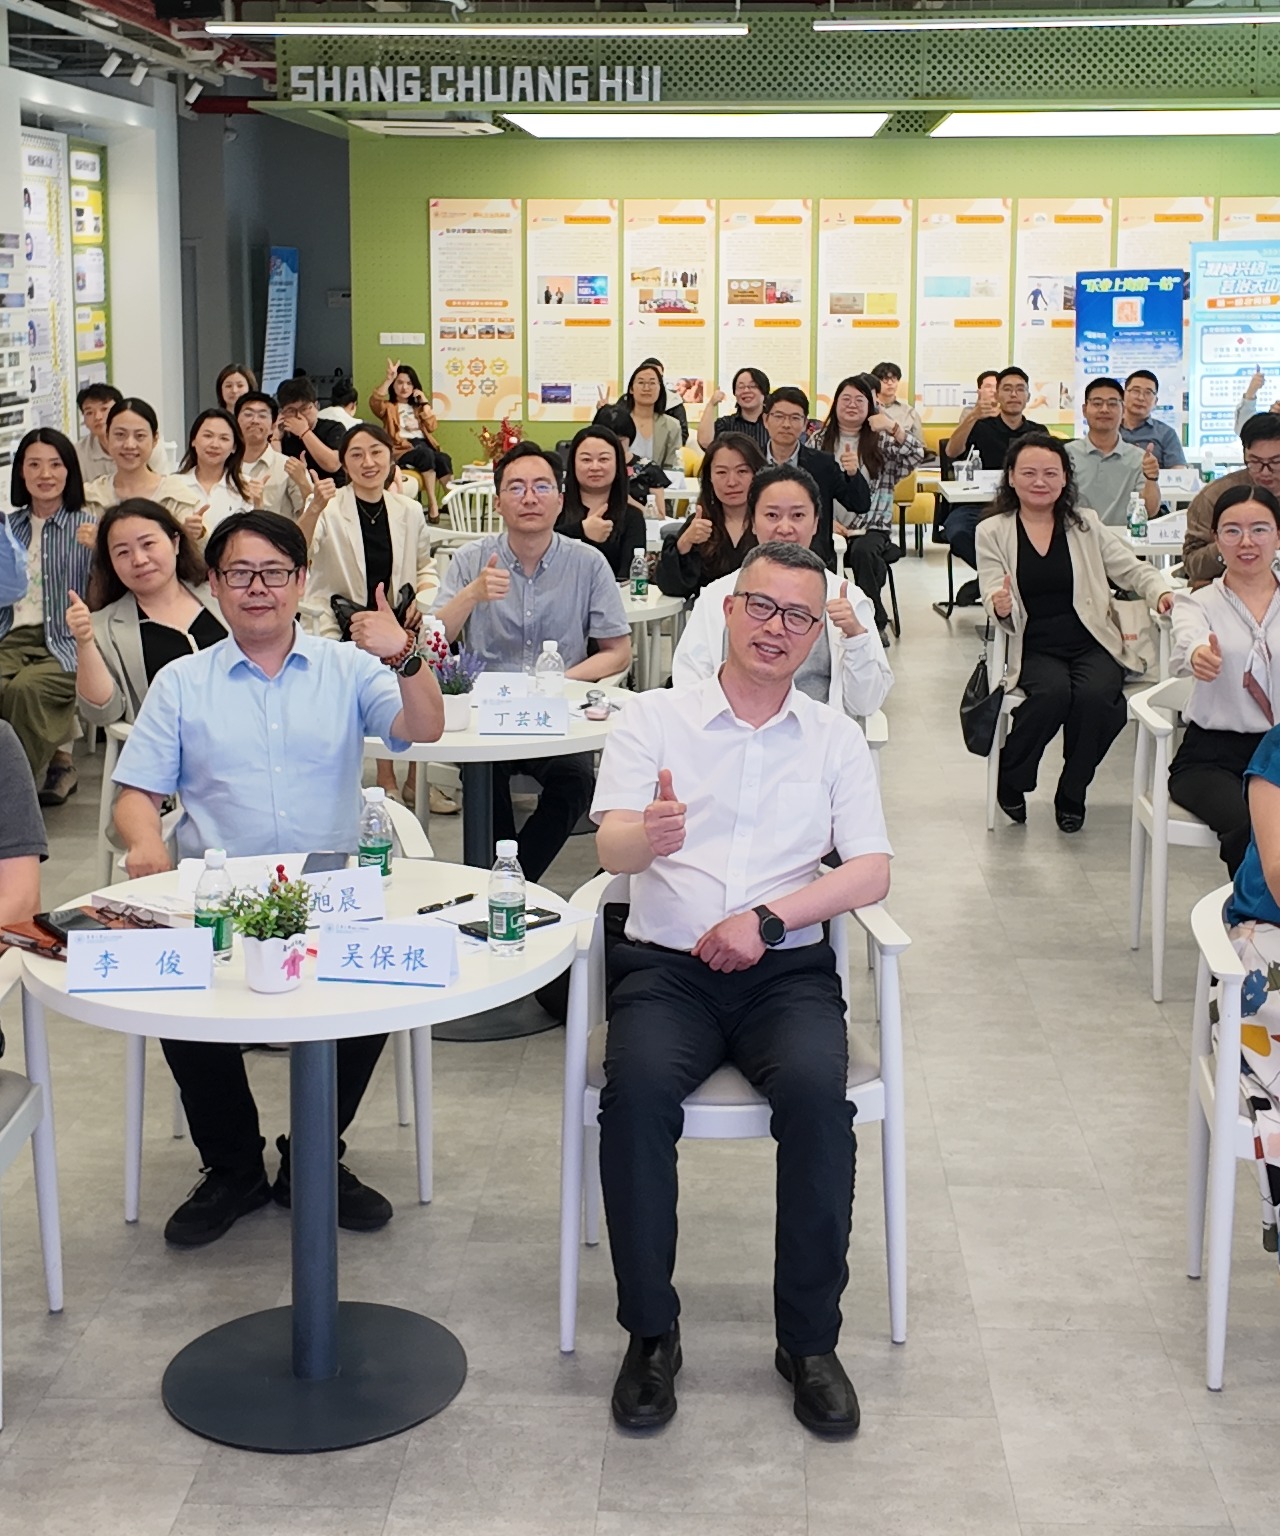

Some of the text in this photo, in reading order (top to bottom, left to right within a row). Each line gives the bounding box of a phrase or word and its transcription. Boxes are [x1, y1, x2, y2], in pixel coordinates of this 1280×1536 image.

[290, 65, 662, 102] SHANG CHUANG HUI
[93, 949, 184, 978] 李 俊
[340, 943, 429, 973] 吴保根
